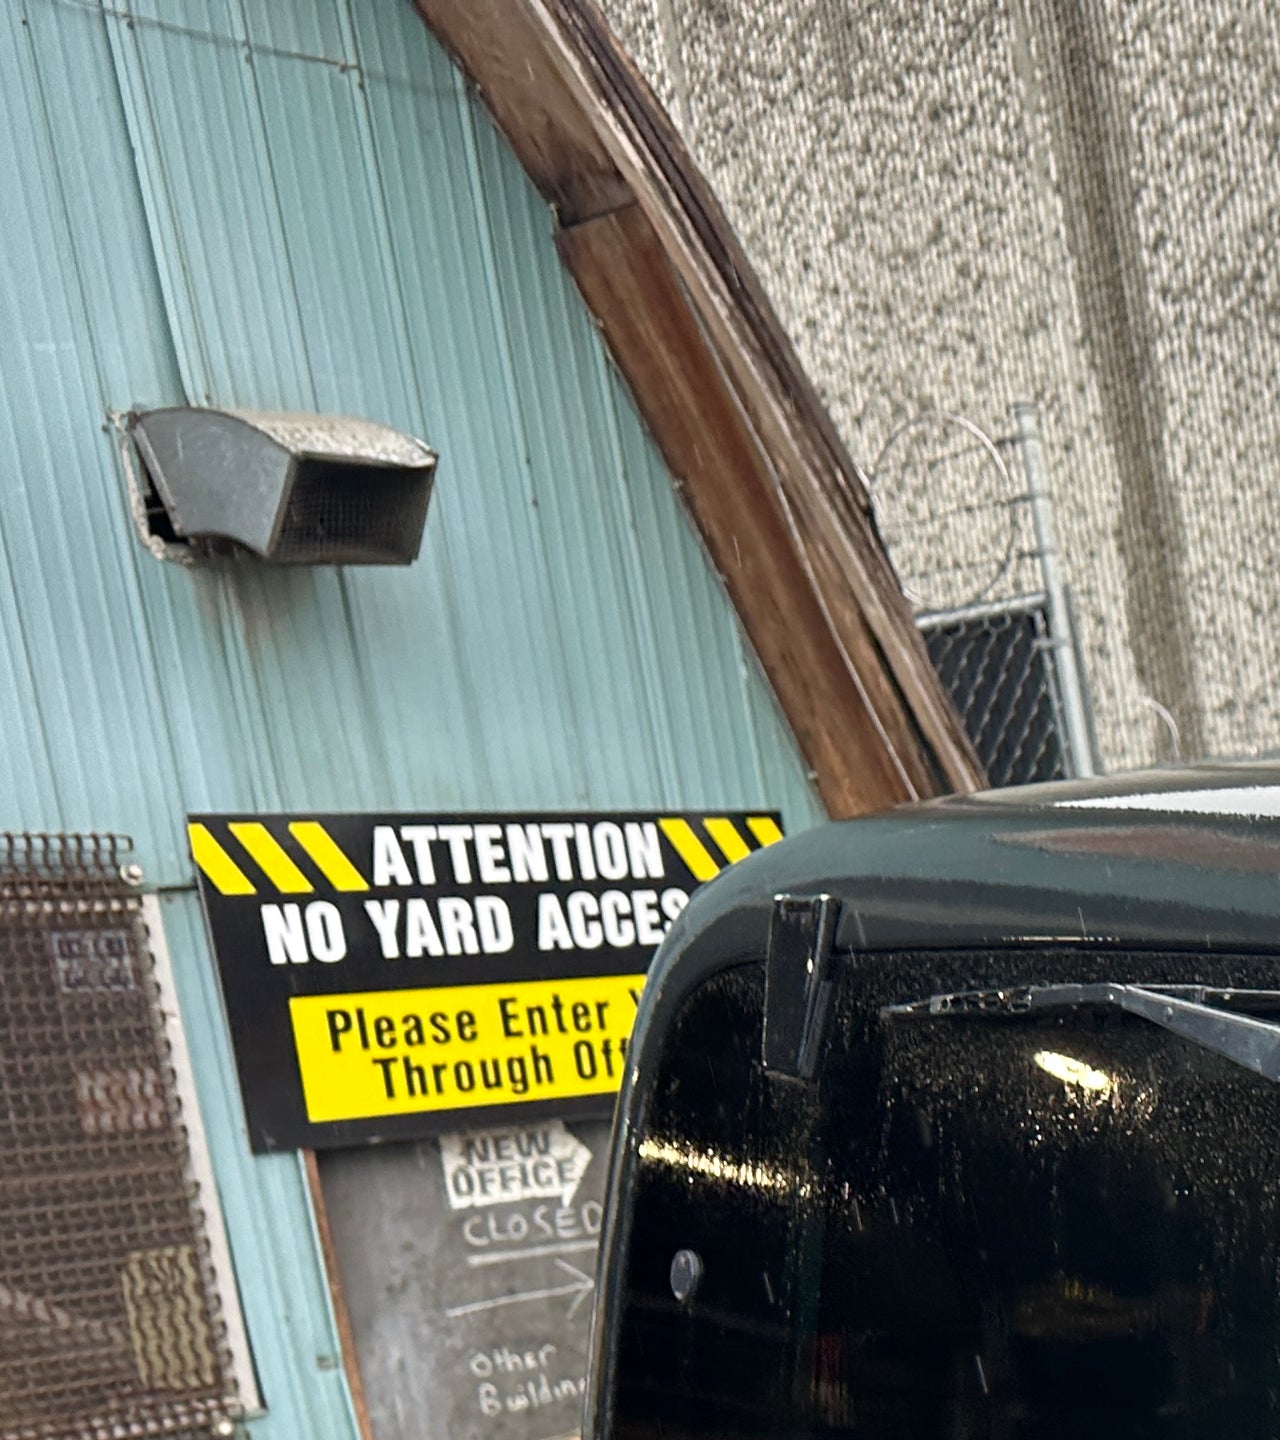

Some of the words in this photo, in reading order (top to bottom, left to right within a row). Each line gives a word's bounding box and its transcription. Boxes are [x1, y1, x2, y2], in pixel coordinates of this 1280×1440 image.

[374, 821, 665, 887] ATTENTION
[260, 900, 347, 966] NO
[364, 894, 514, 959] YARD
[325, 1004, 479, 1052] Please
[499, 996, 610, 1037] Enter
[373, 1044, 555, 1099] Through
[465, 1130, 550, 1163] NEW
[452, 1161, 578, 1197] OFFICE
[463, 1200, 604, 1246] CLOSED
[469, 1344, 557, 1378] Other
